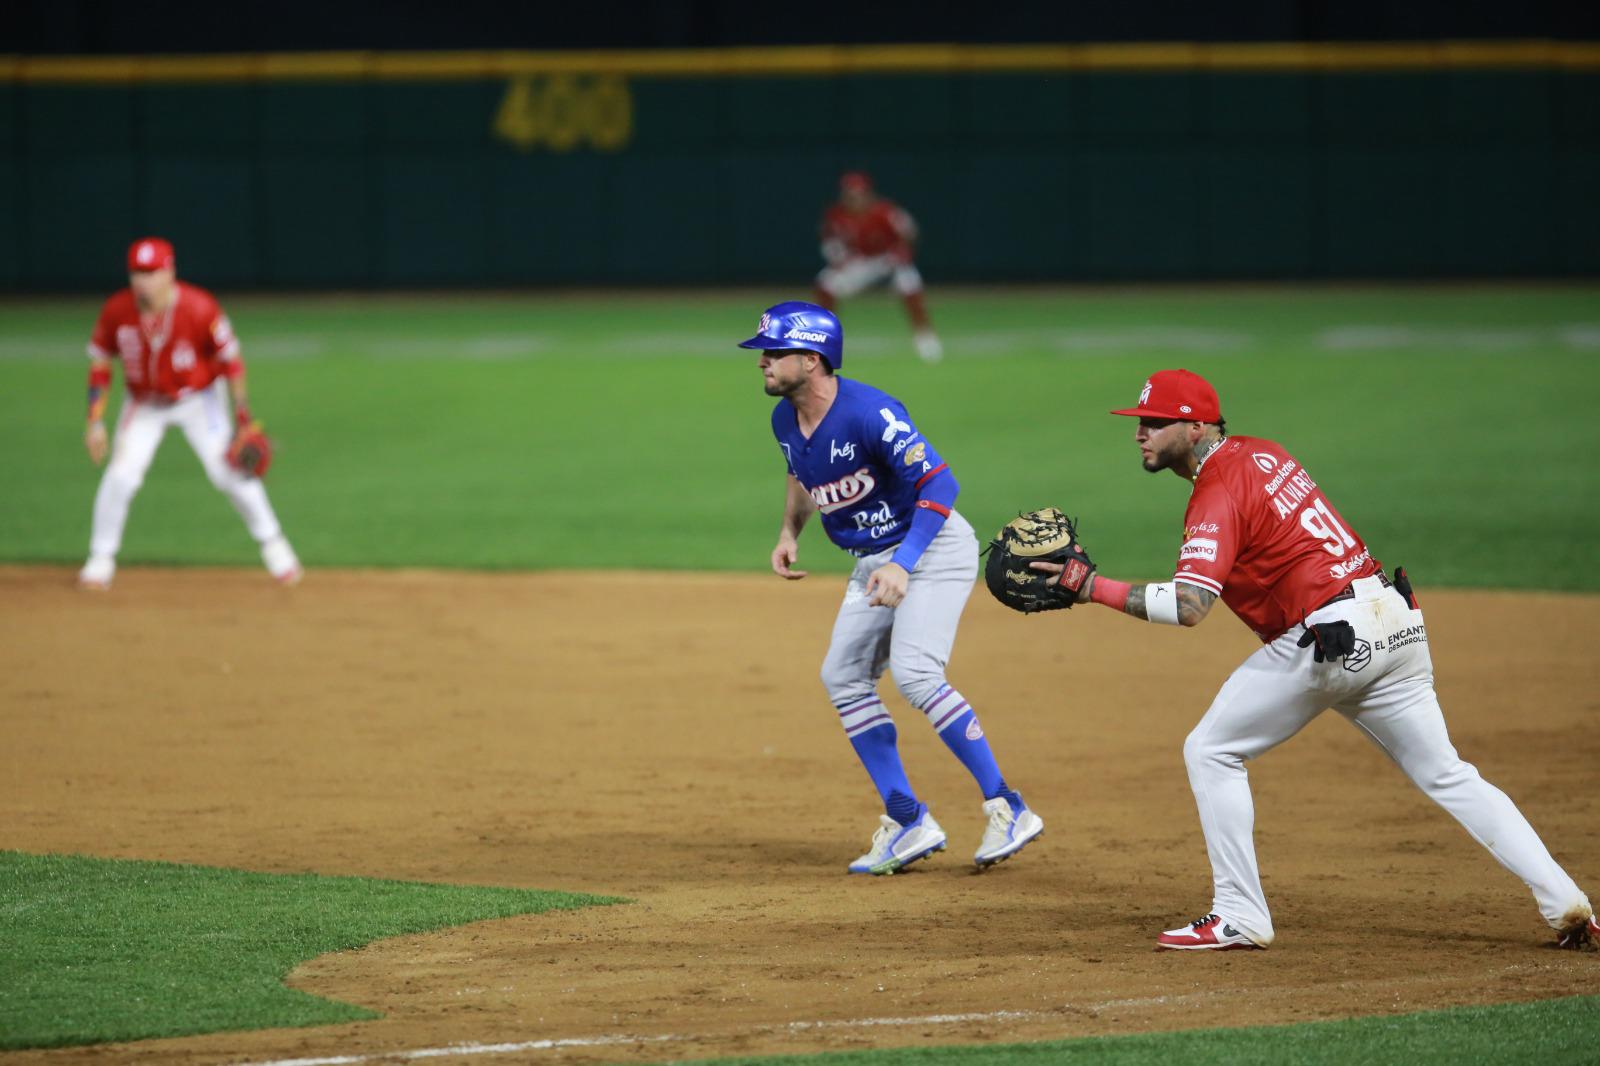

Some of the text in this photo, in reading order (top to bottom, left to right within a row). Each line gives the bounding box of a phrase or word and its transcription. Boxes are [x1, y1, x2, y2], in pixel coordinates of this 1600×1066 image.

[495, 76, 632, 150] 400
[811, 467, 876, 515] arros
[851, 500, 896, 532] Red
[1300, 497, 1357, 556] 91
[1374, 625, 1424, 650] EL ENCANT
[1388, 635, 1427, 653] DESARROLL
